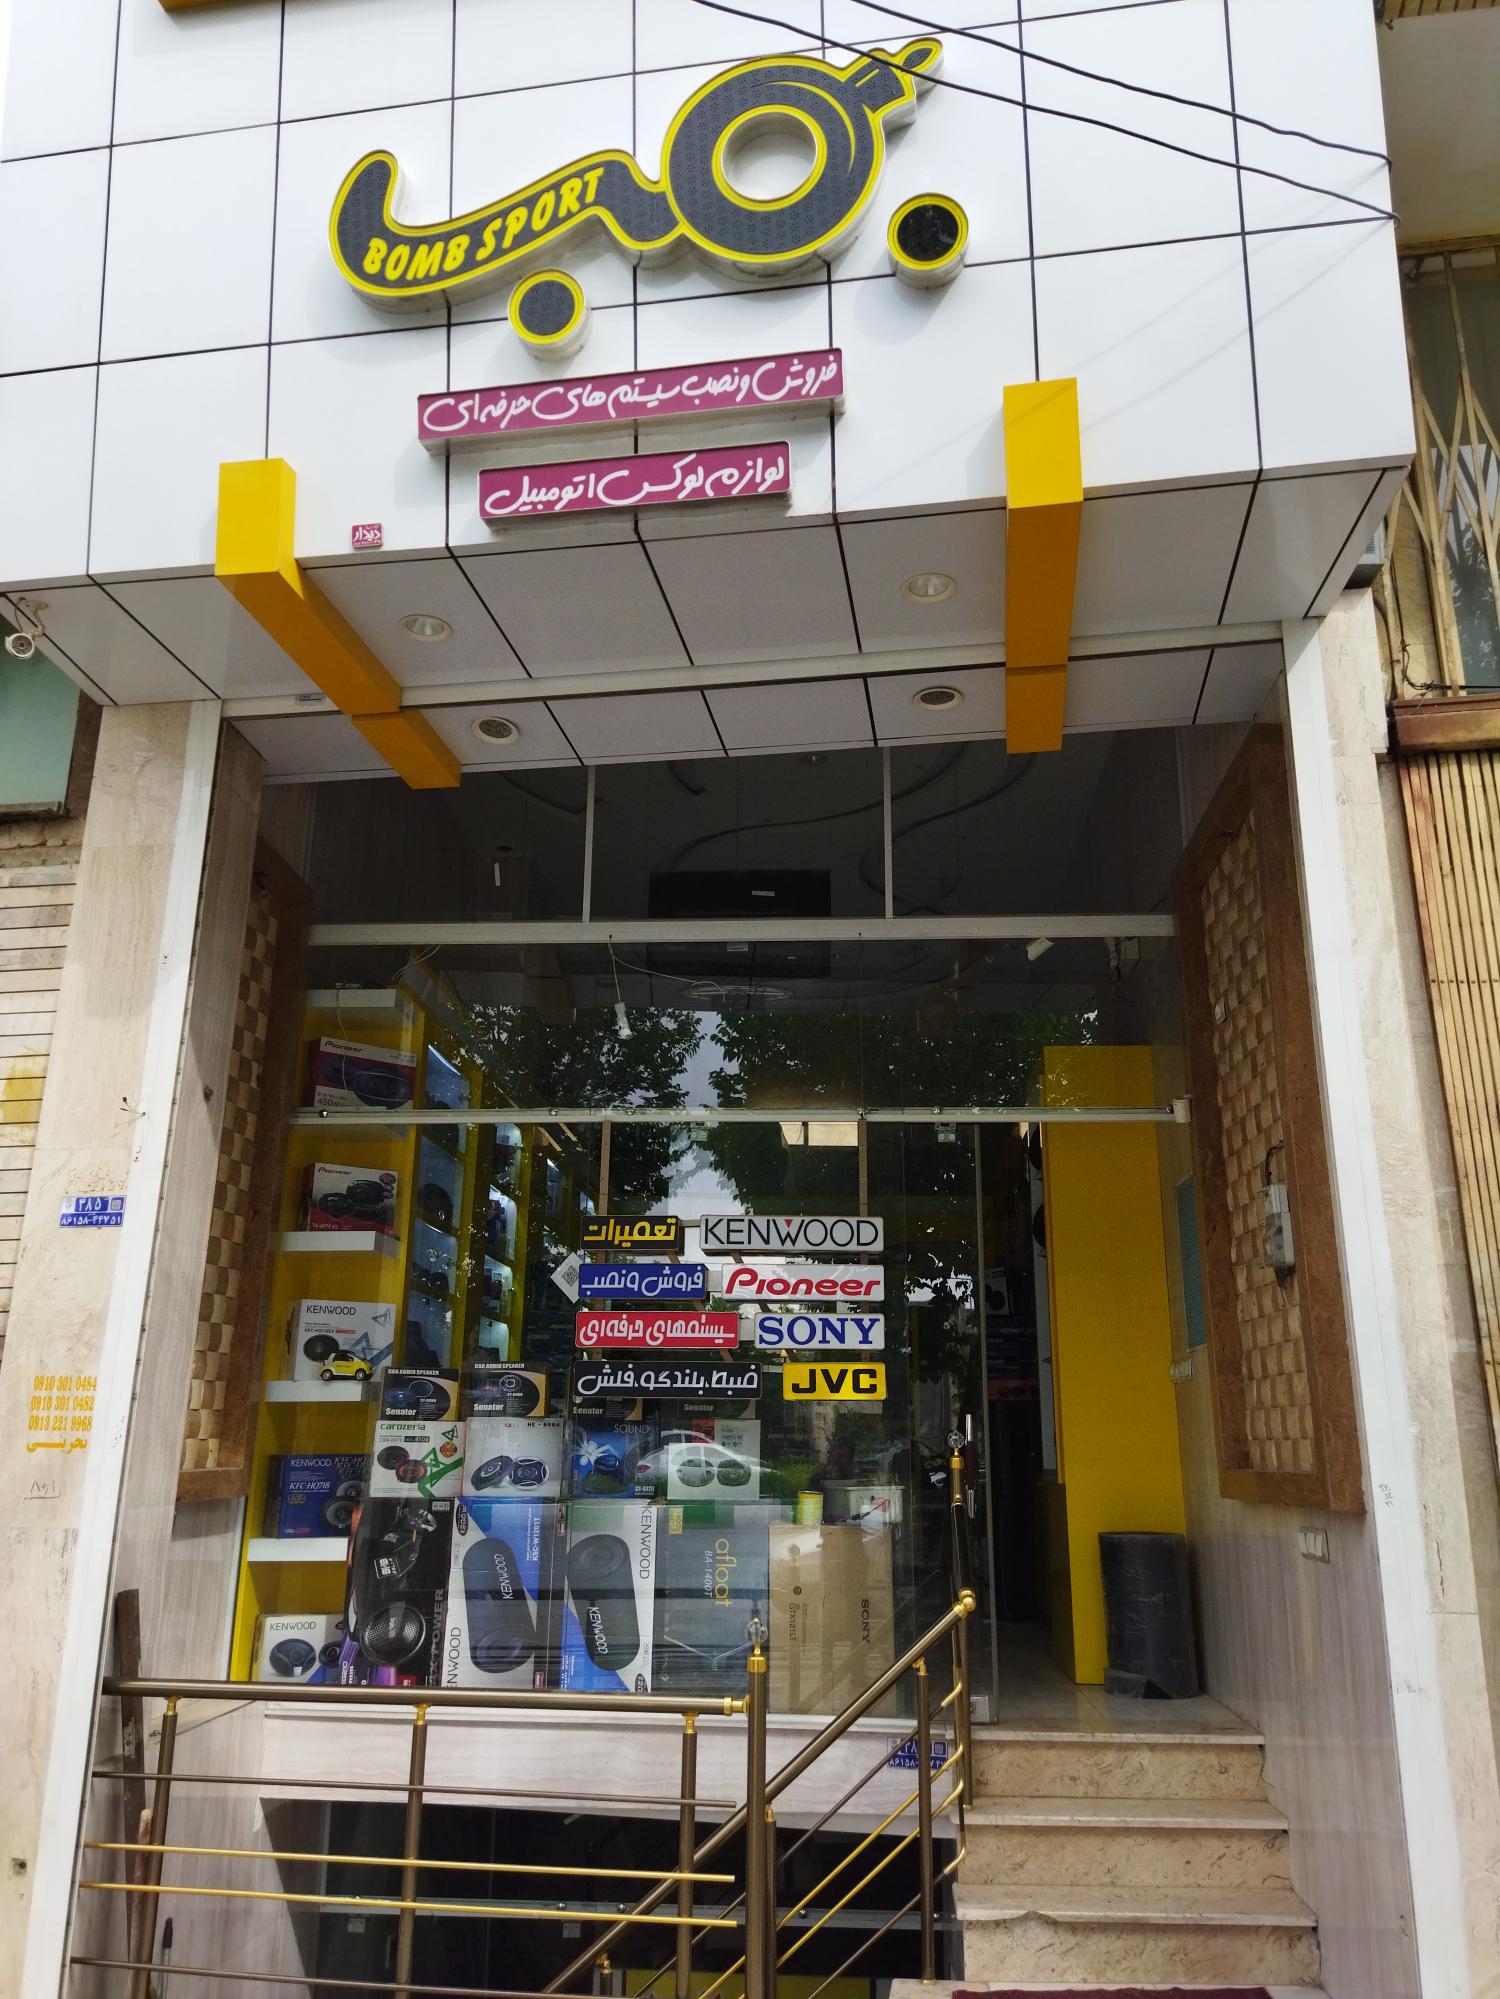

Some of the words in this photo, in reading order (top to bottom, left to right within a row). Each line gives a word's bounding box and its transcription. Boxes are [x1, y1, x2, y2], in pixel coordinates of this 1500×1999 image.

[363, 234, 470, 281] BOMB
[475, 167, 605, 261] SPORT
[752, 355, 838, 400] فروش
[597, 453, 704, 506] لوکس
[705, 456, 785, 496] لوازم
[484, 474, 595, 515] اتومبیل
[324, 1040, 364, 1053] Pioneer
[317, 1166, 353, 1176] Pioneer
[78, 1197, 102, 1212] ۳۸۵
[583, 1217, 677, 1248] تعمیرات
[704, 1218, 879, 1247] KENWOOD
[641, 1265, 704, 1297] فروش
[724, 1267, 881, 1296] Pioneer
[306, 1304, 357, 1316] KENWOOD
[758, 1315, 881, 1346] SONY
[791, 1368, 878, 1394] JVC
[385, 1407, 417, 1416] Senator
[473, 1403, 504, 1411] Senator
[572, 1406, 604, 1415] Senator
[683, 1403, 714, 1412] Senator
[614, 1423, 649, 1434] SOUND
[290, 1458, 332, 1467] KENWOOD
[640, 1506, 653, 1580] KENWOOD
[494, 1553, 514, 1600] KENWOOD
[715, 1538, 737, 1607] afloat
[269, 1621, 317, 1631] KENWOOD
[587, 1605, 608, 1655] KENWOOD
[861, 1598, 870, 1644] SONY
